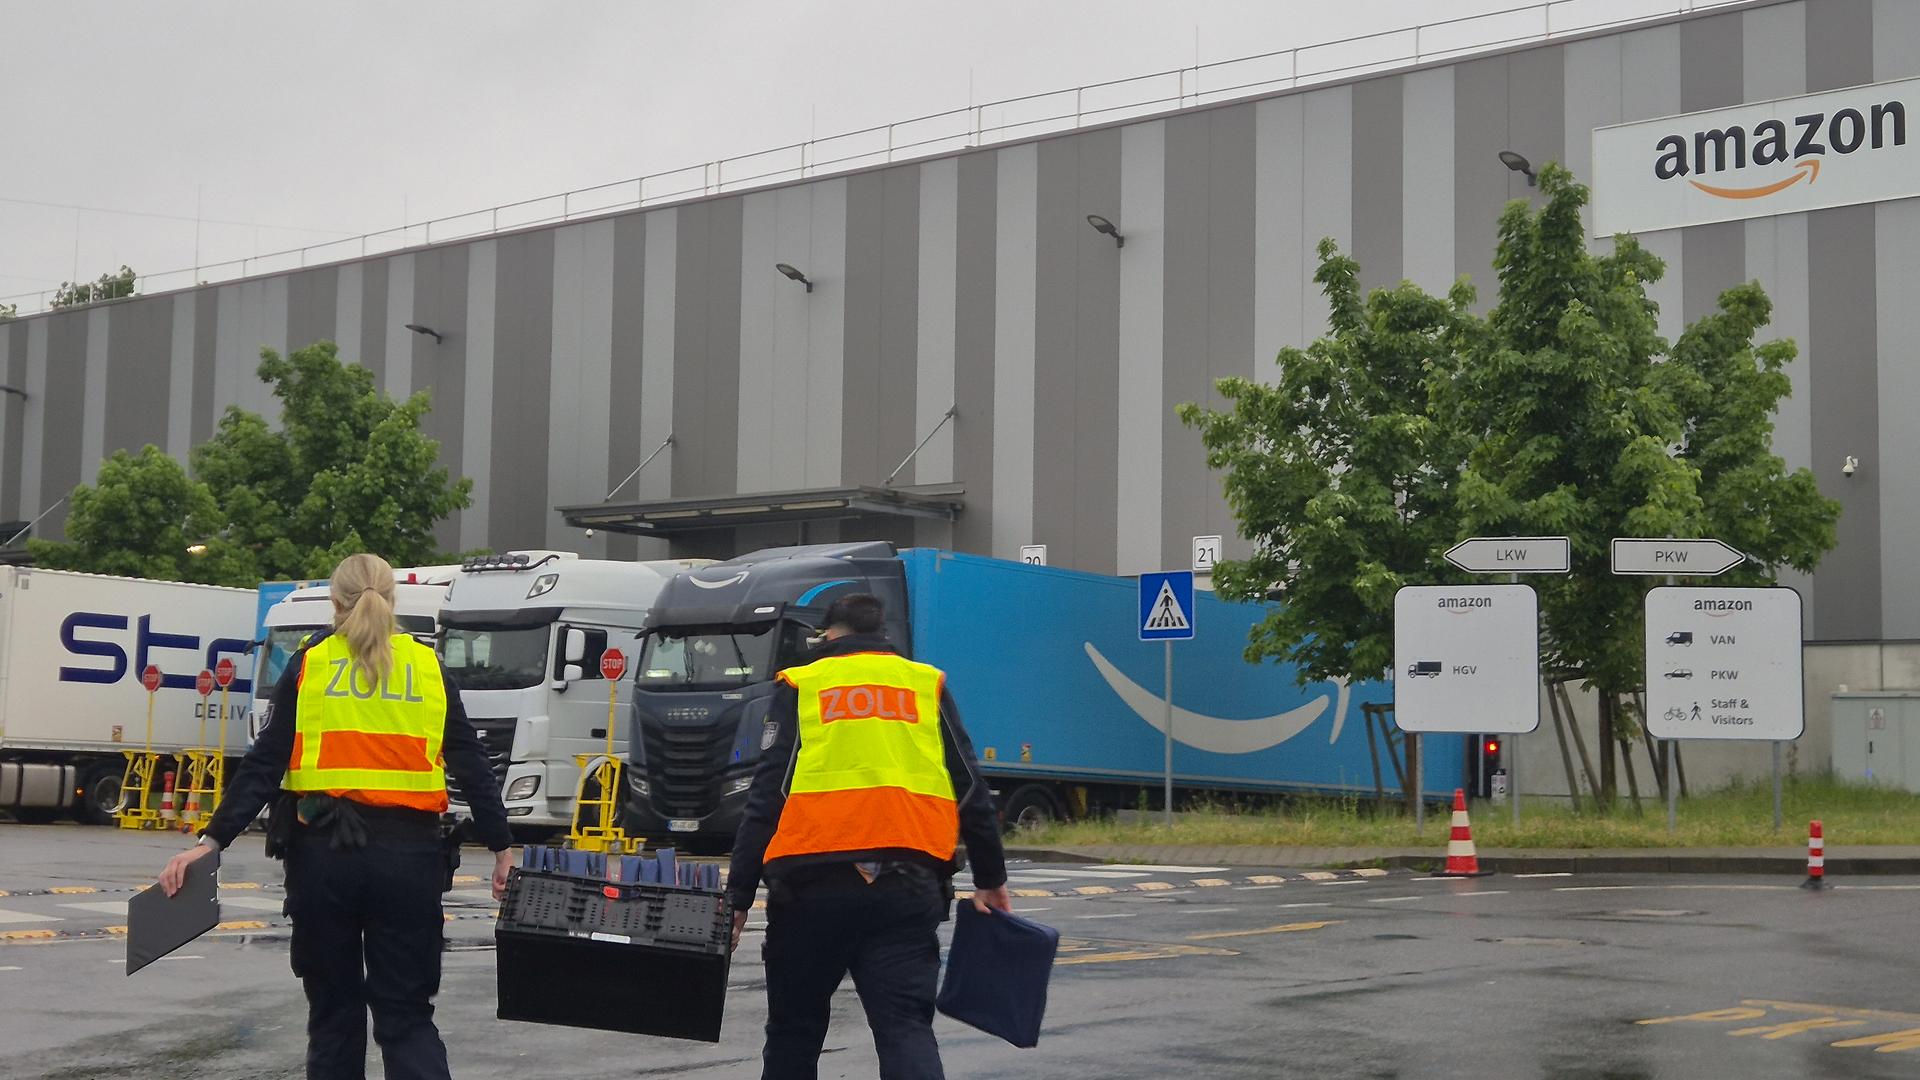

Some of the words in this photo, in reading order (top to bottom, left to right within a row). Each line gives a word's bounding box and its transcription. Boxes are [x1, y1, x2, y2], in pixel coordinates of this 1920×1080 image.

[1655, 100, 1906, 180] amazon
[1198, 547, 1215, 563] 21
[1496, 549, 1528, 562] LKW
[1655, 551, 1689, 563] PKW
[1438, 597, 1492, 609] amazon
[1694, 599, 1753, 611] amazon
[1710, 635, 1736, 645] VAN
[602, 658, 623, 670] STOP
[1452, 665, 1477, 675] HGV
[325, 657, 424, 703] ZOLL
[1711, 670, 1740, 680] PKW
[820, 686, 917, 721] ZOLL
[1711, 698, 1737, 709] Staff
[1739, 699, 1750, 709] &
[667, 706, 709, 720] IVECO
[1711, 714, 1754, 726] Visitors
